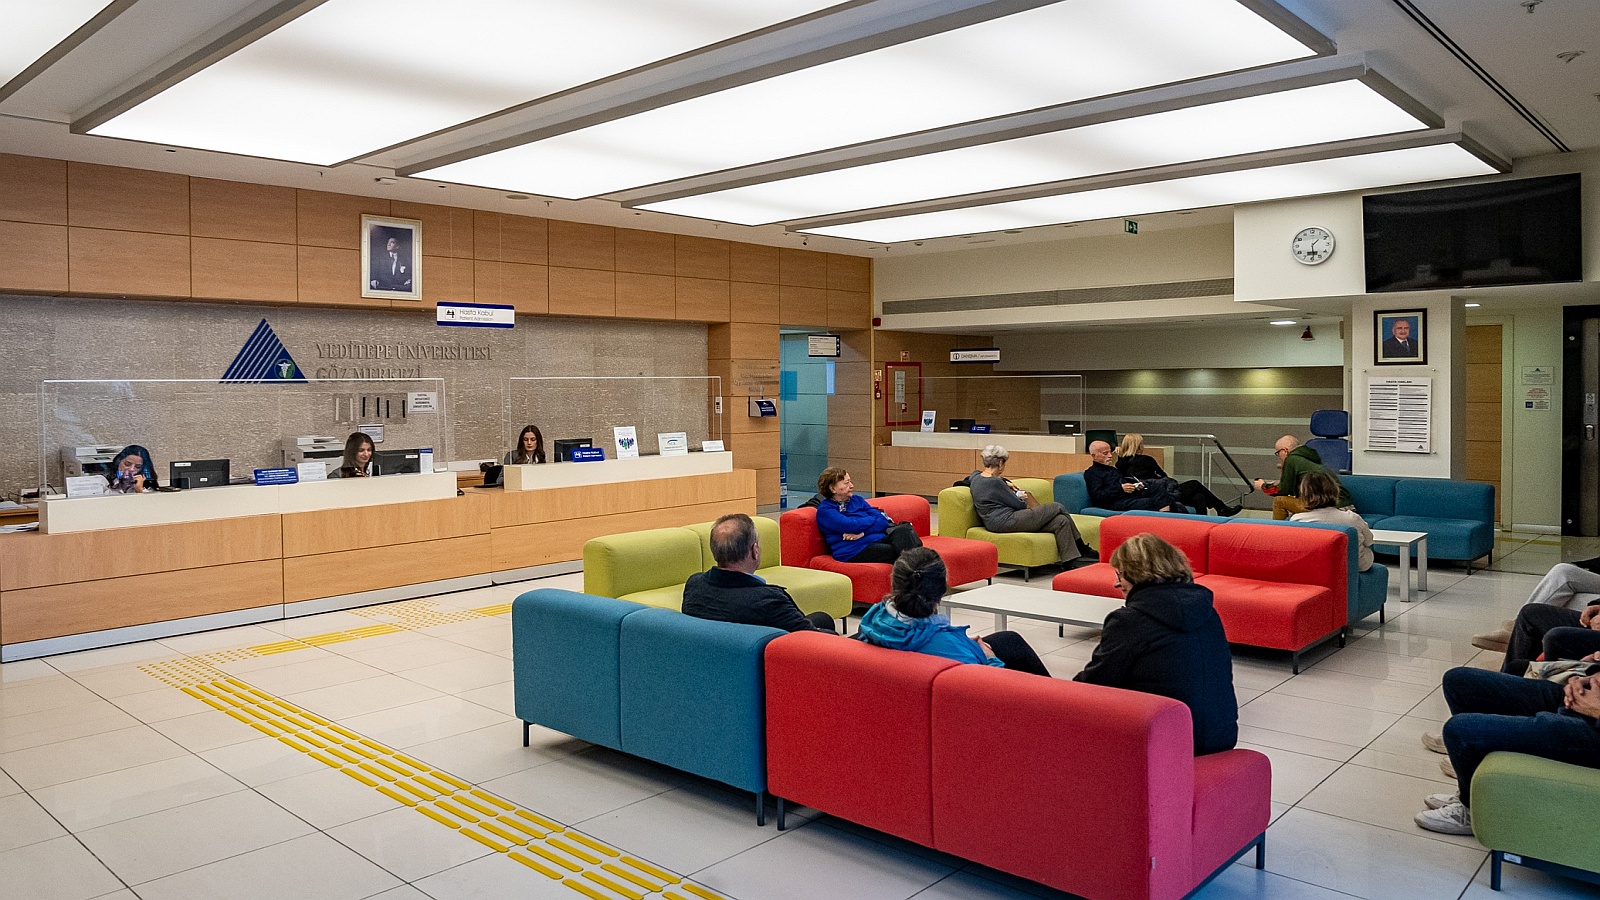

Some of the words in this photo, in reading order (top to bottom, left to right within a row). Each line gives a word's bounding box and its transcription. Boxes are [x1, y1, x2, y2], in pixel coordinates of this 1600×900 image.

[316, 341, 393, 359] YEDİTEPE
[396, 342, 493, 360] ÜNİVERSİTESİ
[316, 365, 348, 382] GÖZ
[353, 365, 422, 382] MERKEZİ
